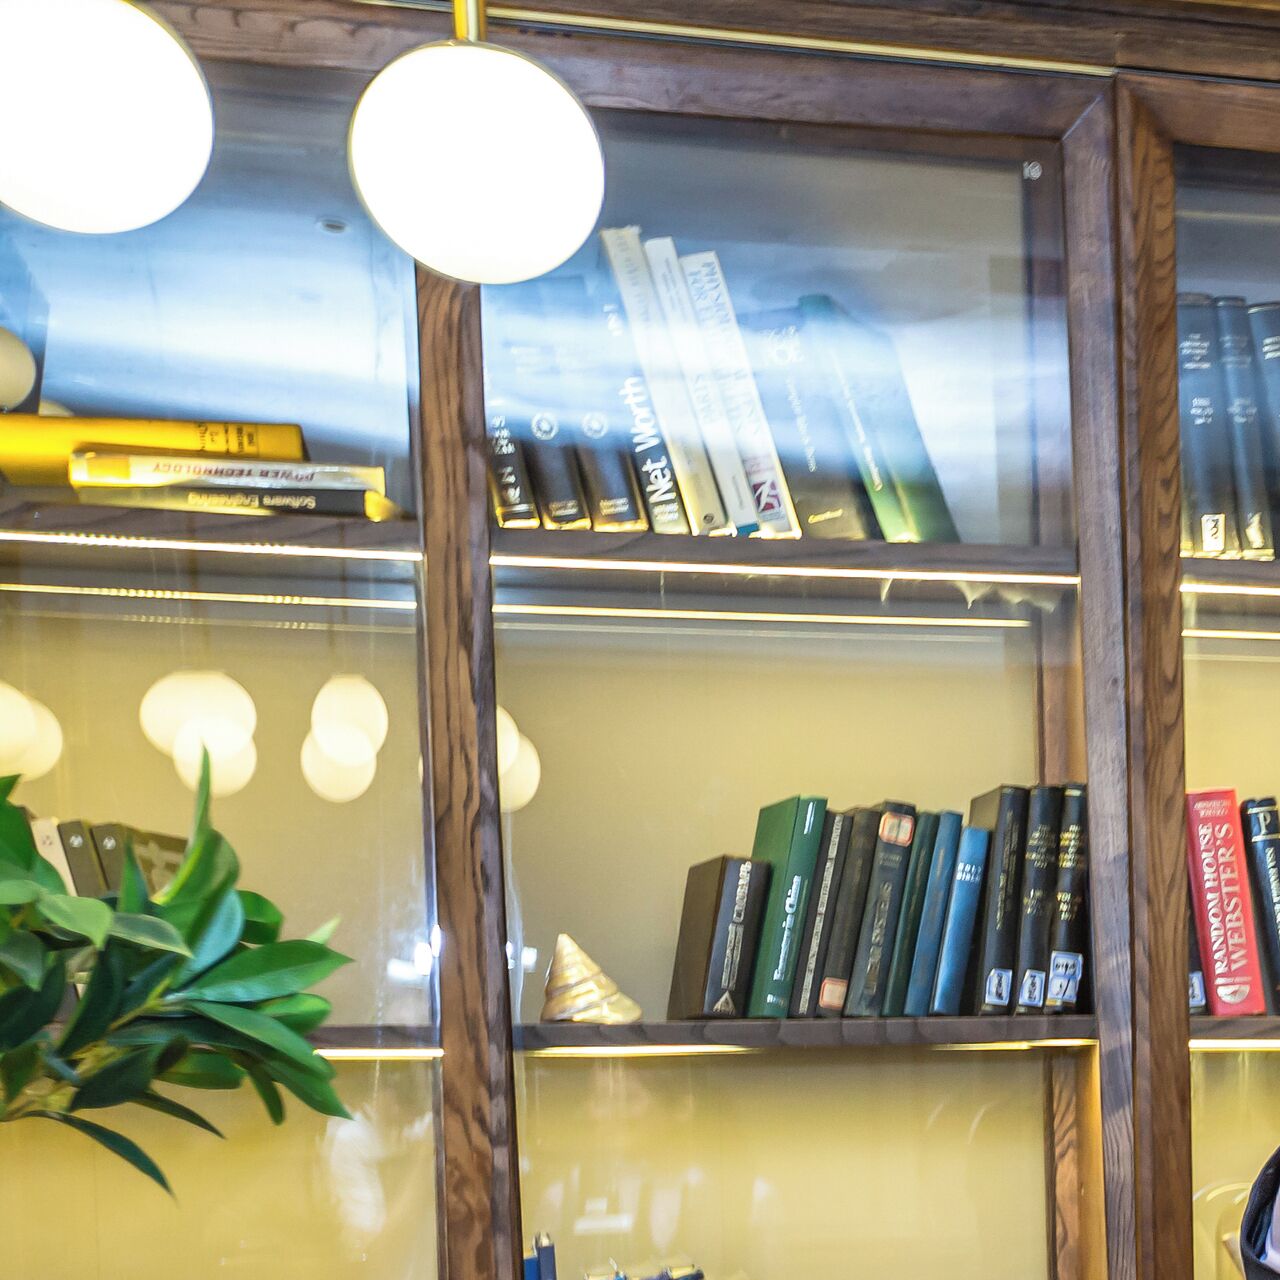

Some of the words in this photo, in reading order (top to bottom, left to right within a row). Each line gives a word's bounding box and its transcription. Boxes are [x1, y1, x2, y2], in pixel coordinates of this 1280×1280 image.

[618, 376, 662, 453] Worth
[642, 455, 677, 504] Net
[1198, 822, 1219, 889] HOUSE
[1206, 891, 1229, 975] RANDOM
[1215, 822, 1249, 972] WEBSTER'S
